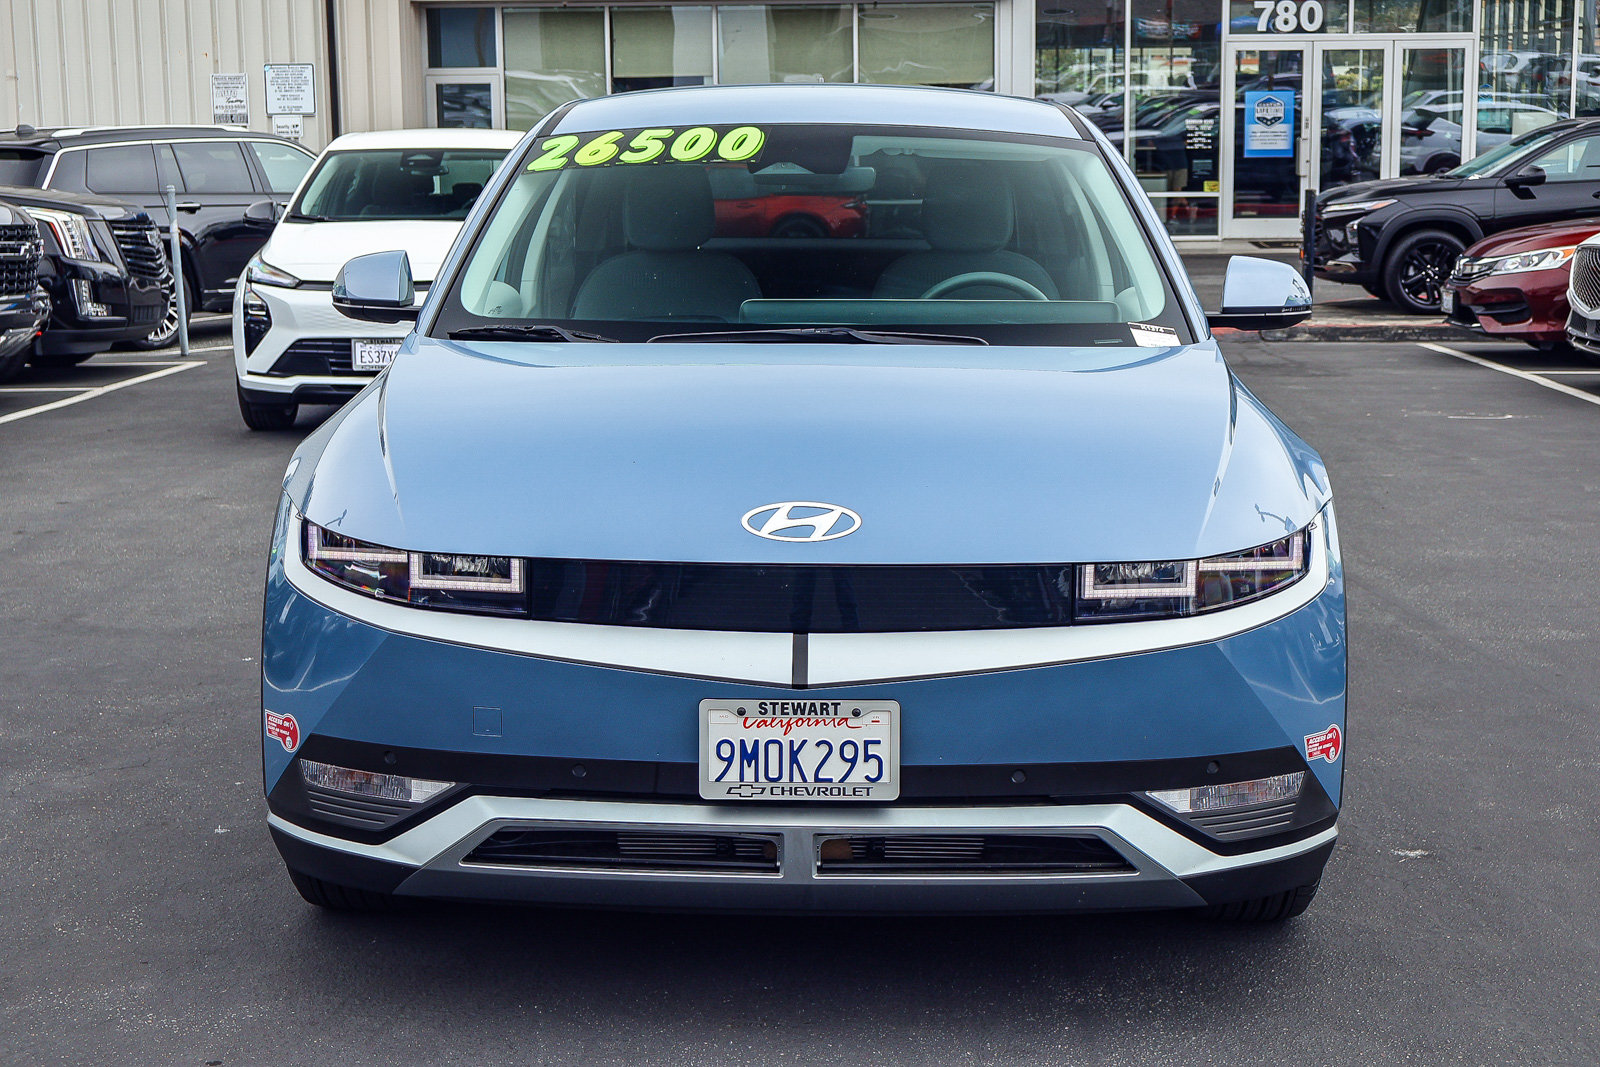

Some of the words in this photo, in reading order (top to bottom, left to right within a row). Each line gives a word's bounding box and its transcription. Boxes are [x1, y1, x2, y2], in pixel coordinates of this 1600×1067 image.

[1254, 0, 1323, 32] 780
[527, 126, 765, 171] 26500
[758, 701, 841, 716] STEWART
[268, 715, 283, 726] ACCESS
[283, 720, 289, 728] OK
[1308, 734, 1326, 745] ACCESS
[715, 738, 884, 783] 9MOK295
[770, 786, 873, 797] CHEVROLET
